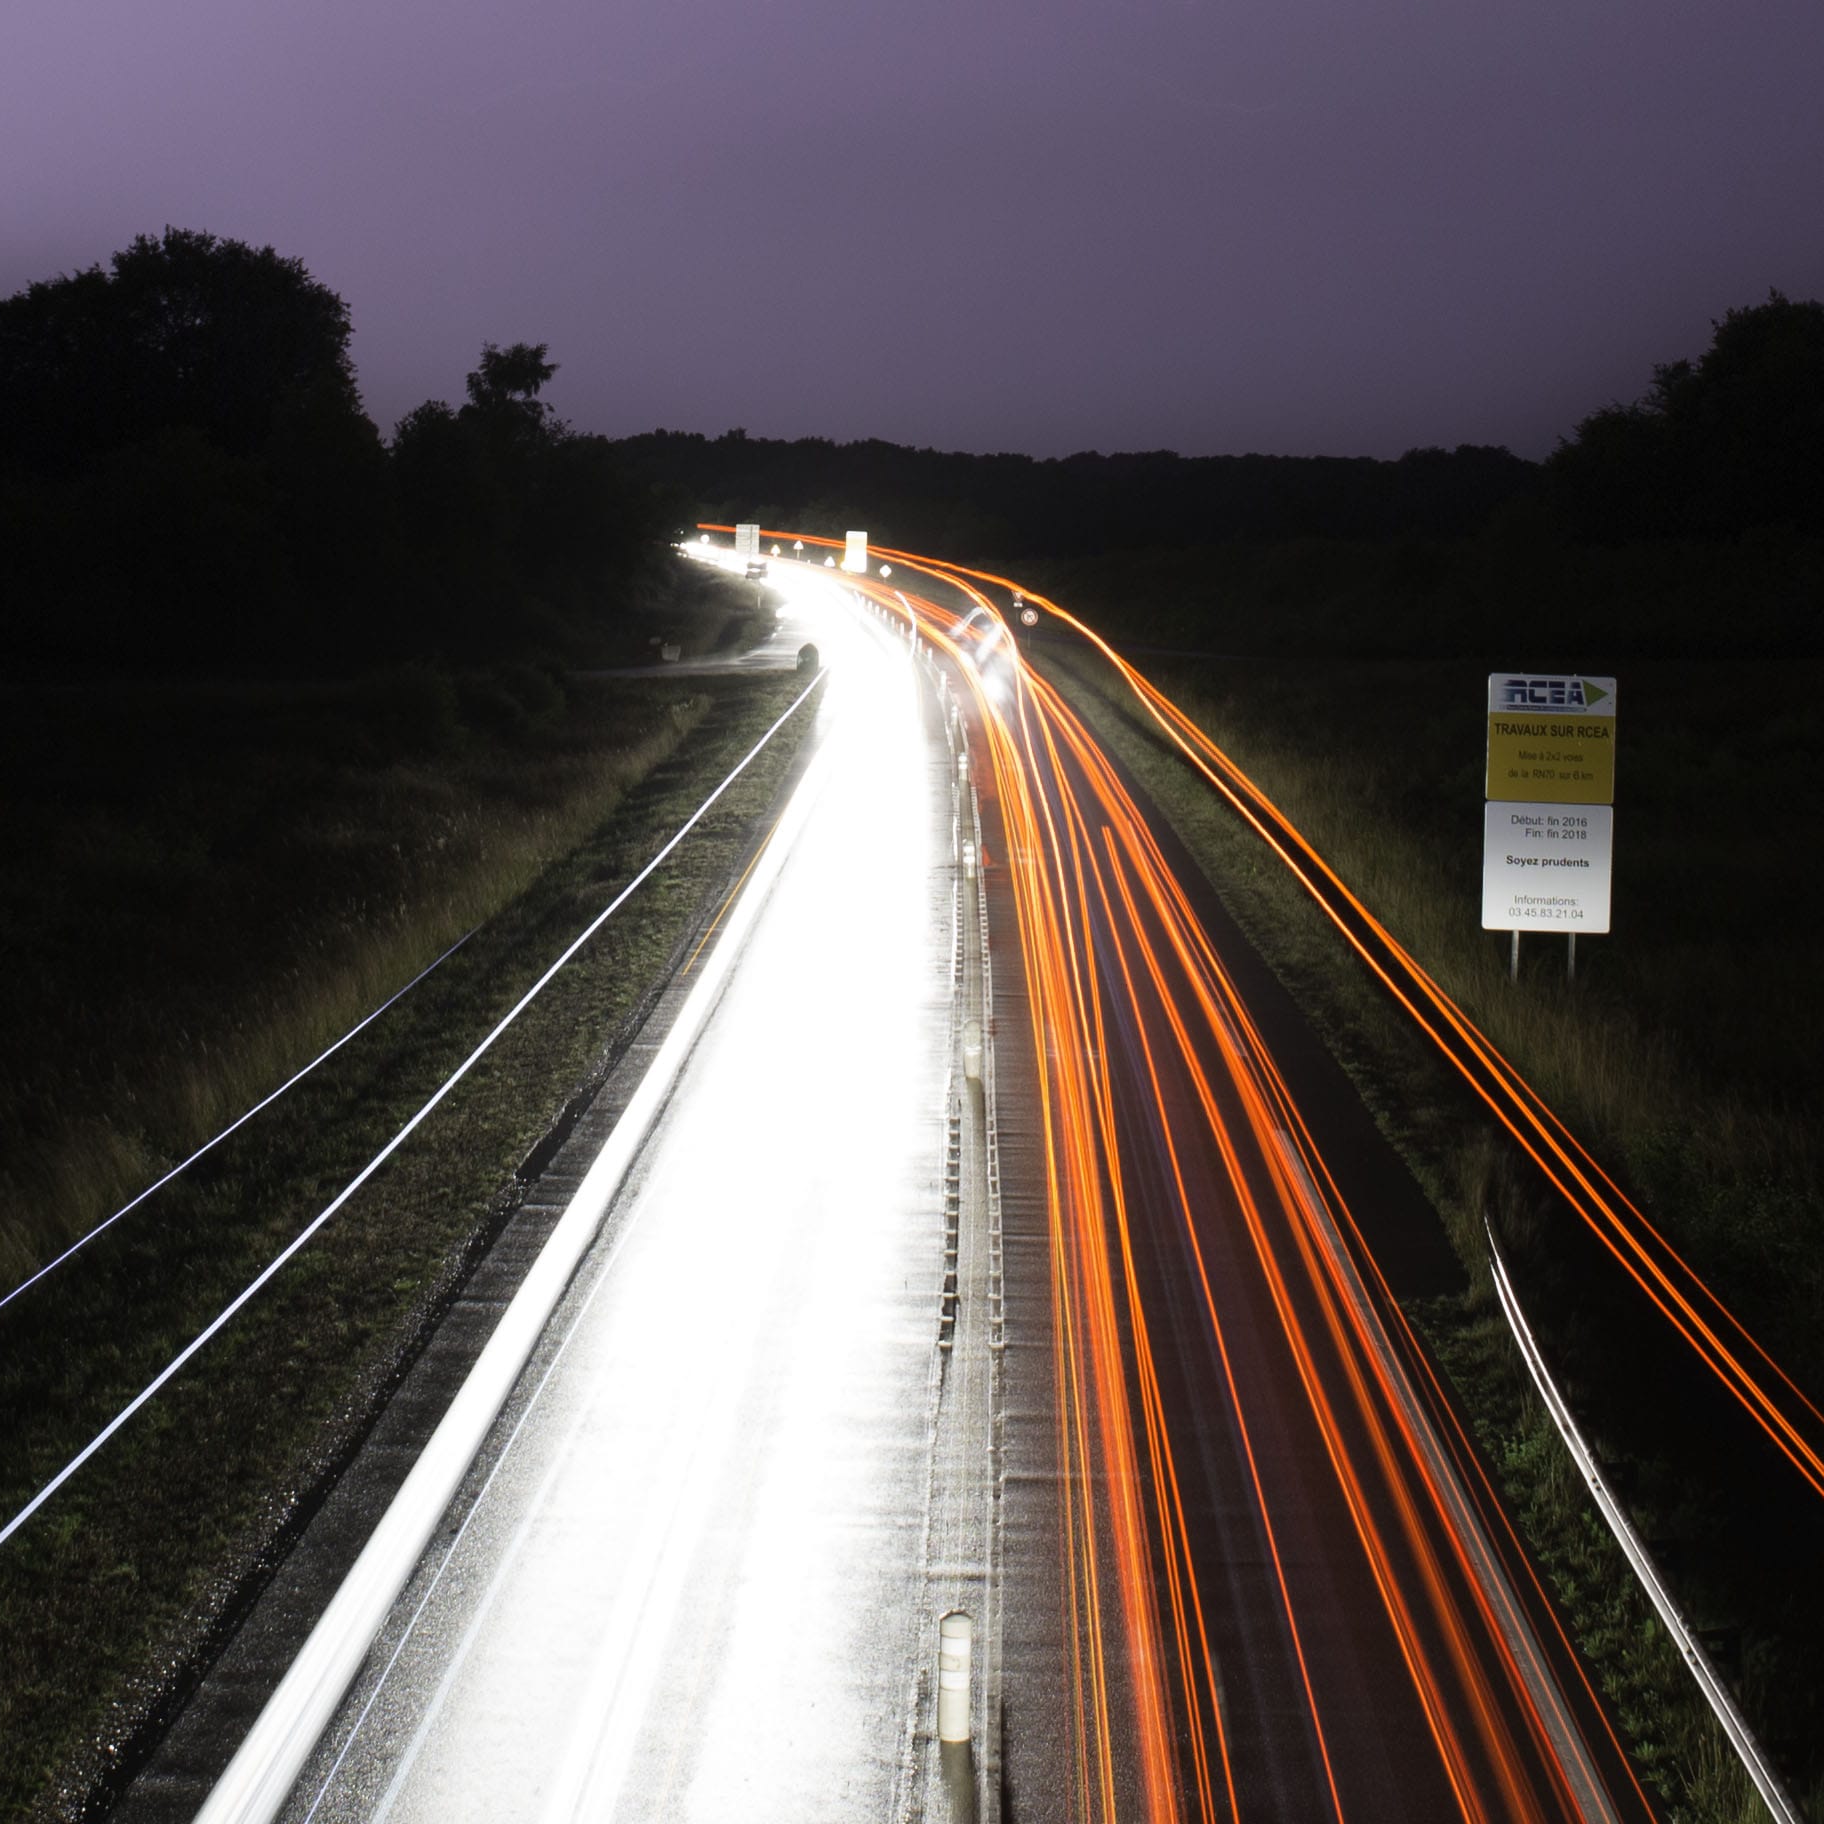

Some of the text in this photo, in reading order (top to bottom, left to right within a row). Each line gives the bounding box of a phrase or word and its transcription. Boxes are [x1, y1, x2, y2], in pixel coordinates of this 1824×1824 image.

[1503, 679, 1585, 705] RCEA
[1494, 723, 1610, 739] TRAVAUX SUR RCEA
[1518, 750, 1584, 762] Mise à 2x2 voies
[1507, 768, 1518, 778] de
[1521, 768, 1529, 778] la
[1532, 769, 1555, 779] RN70
[1559, 772, 1571, 780] sur
[1581, 770, 1594, 780] km
[1511, 814, 1588, 827] Début: fin 2016
[1525, 828, 1587, 840] Fin: fin 2018
[1506, 855, 1590, 868] Soyez prudents
[1514, 895, 1578, 906] Informations:
